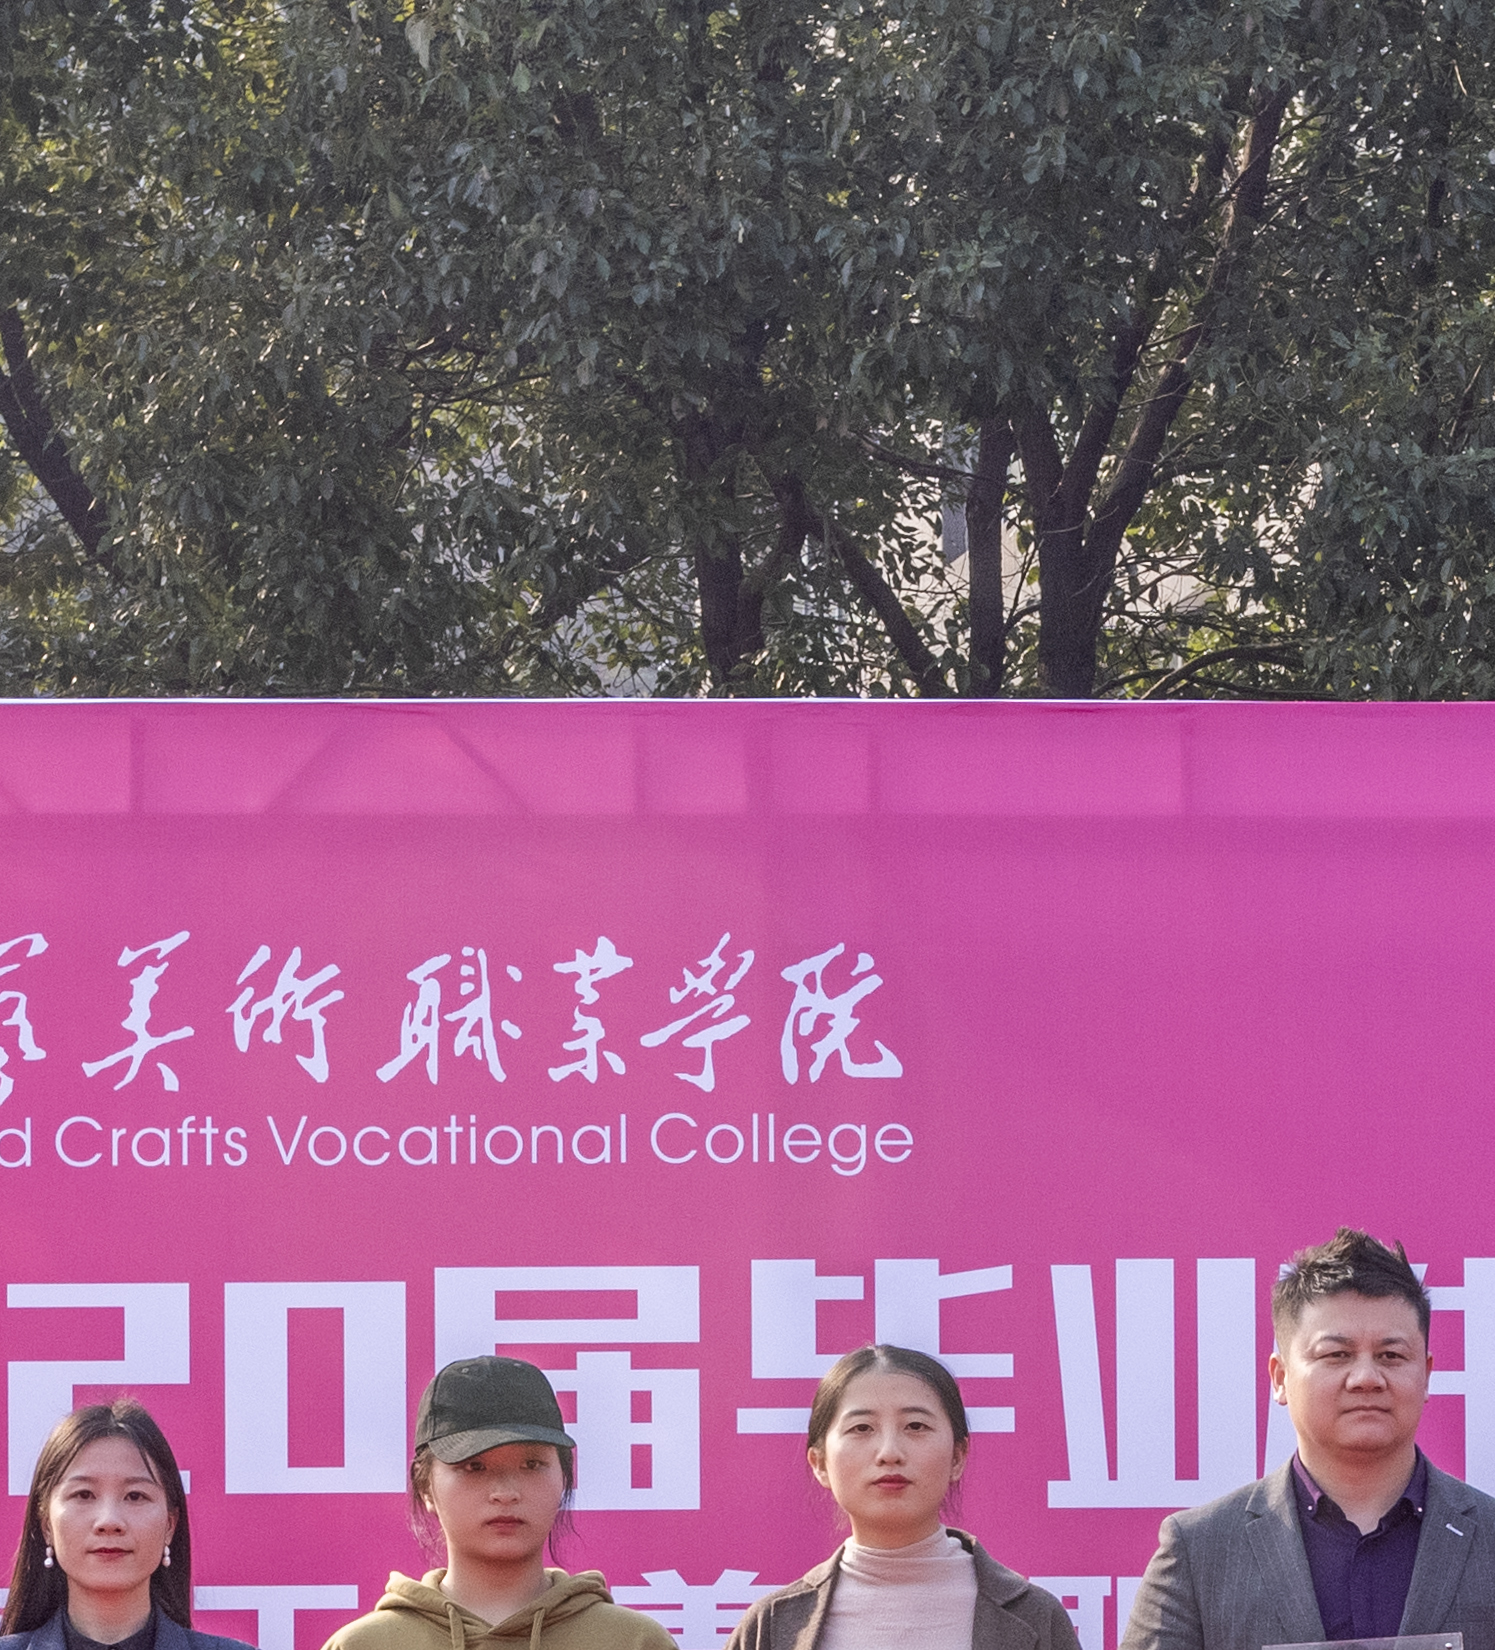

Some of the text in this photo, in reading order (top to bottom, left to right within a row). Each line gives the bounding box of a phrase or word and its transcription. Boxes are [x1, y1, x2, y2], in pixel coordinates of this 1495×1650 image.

[54, 1115, 248, 1168] Crafts
[267, 1113, 627, 1167] Vocational
[650, 1112, 914, 1176] College
